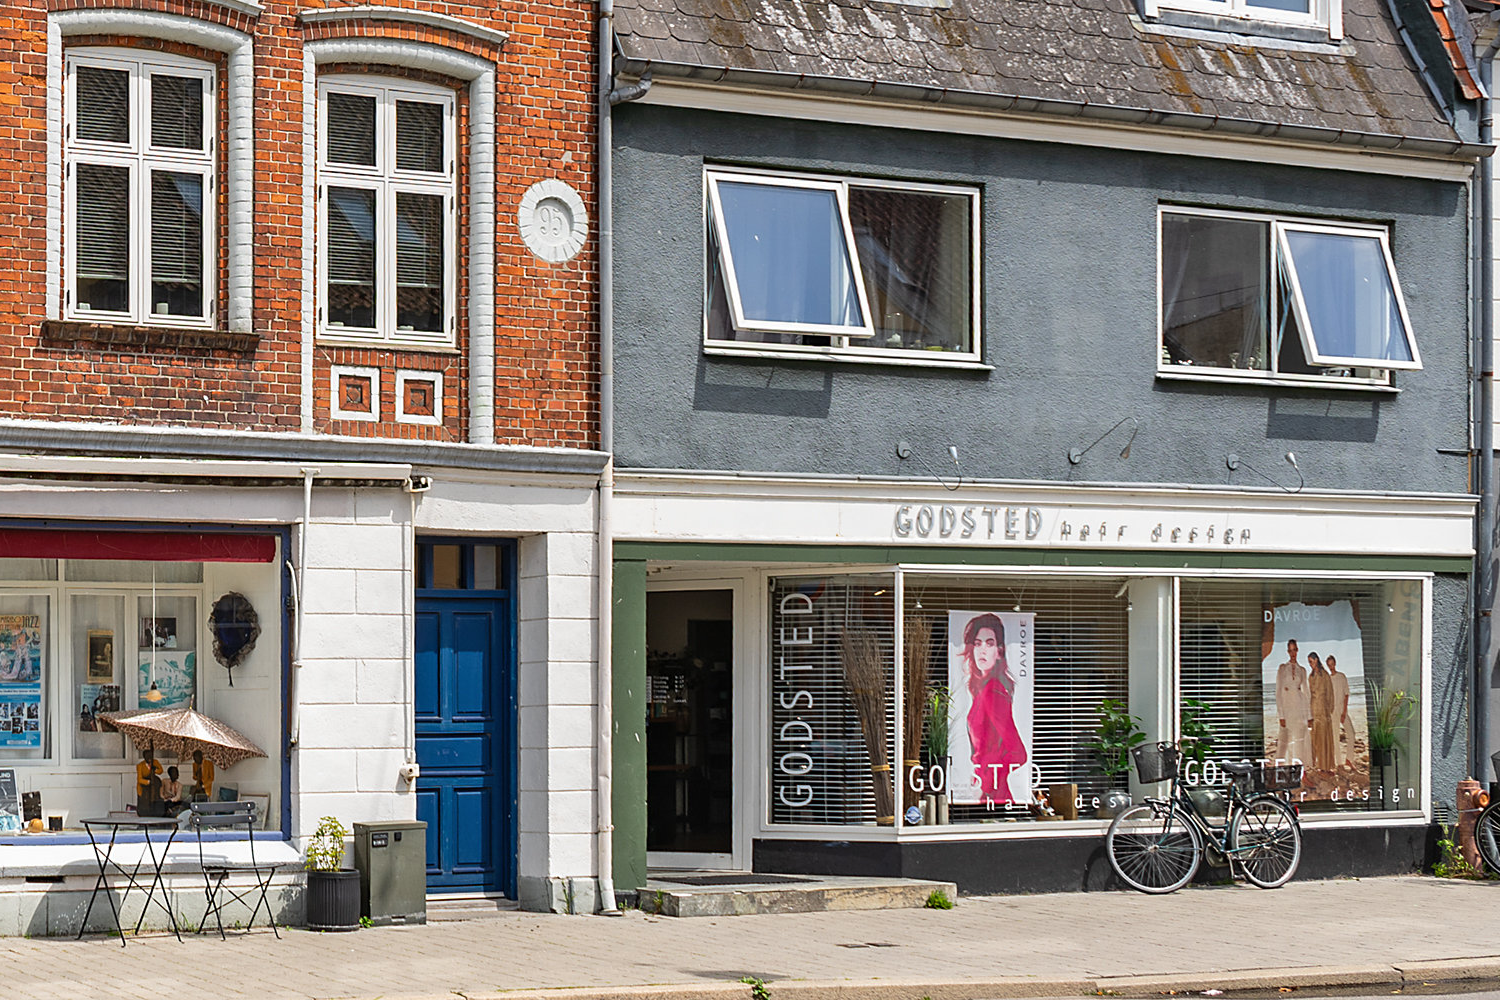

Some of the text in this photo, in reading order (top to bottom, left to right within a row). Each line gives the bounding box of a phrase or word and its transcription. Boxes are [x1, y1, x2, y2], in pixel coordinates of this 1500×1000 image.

[539, 207, 563, 236] 95
[895, 504, 1251, 544] GODSTED hair design
[1264, 608, 1321, 623] DAVROE
[1019, 619, 1027, 677] DAVROE
[780, 593, 813, 807] GODSTED
[909, 763, 1041, 792] GOSTED
[1330, 785, 1415, 803] design
